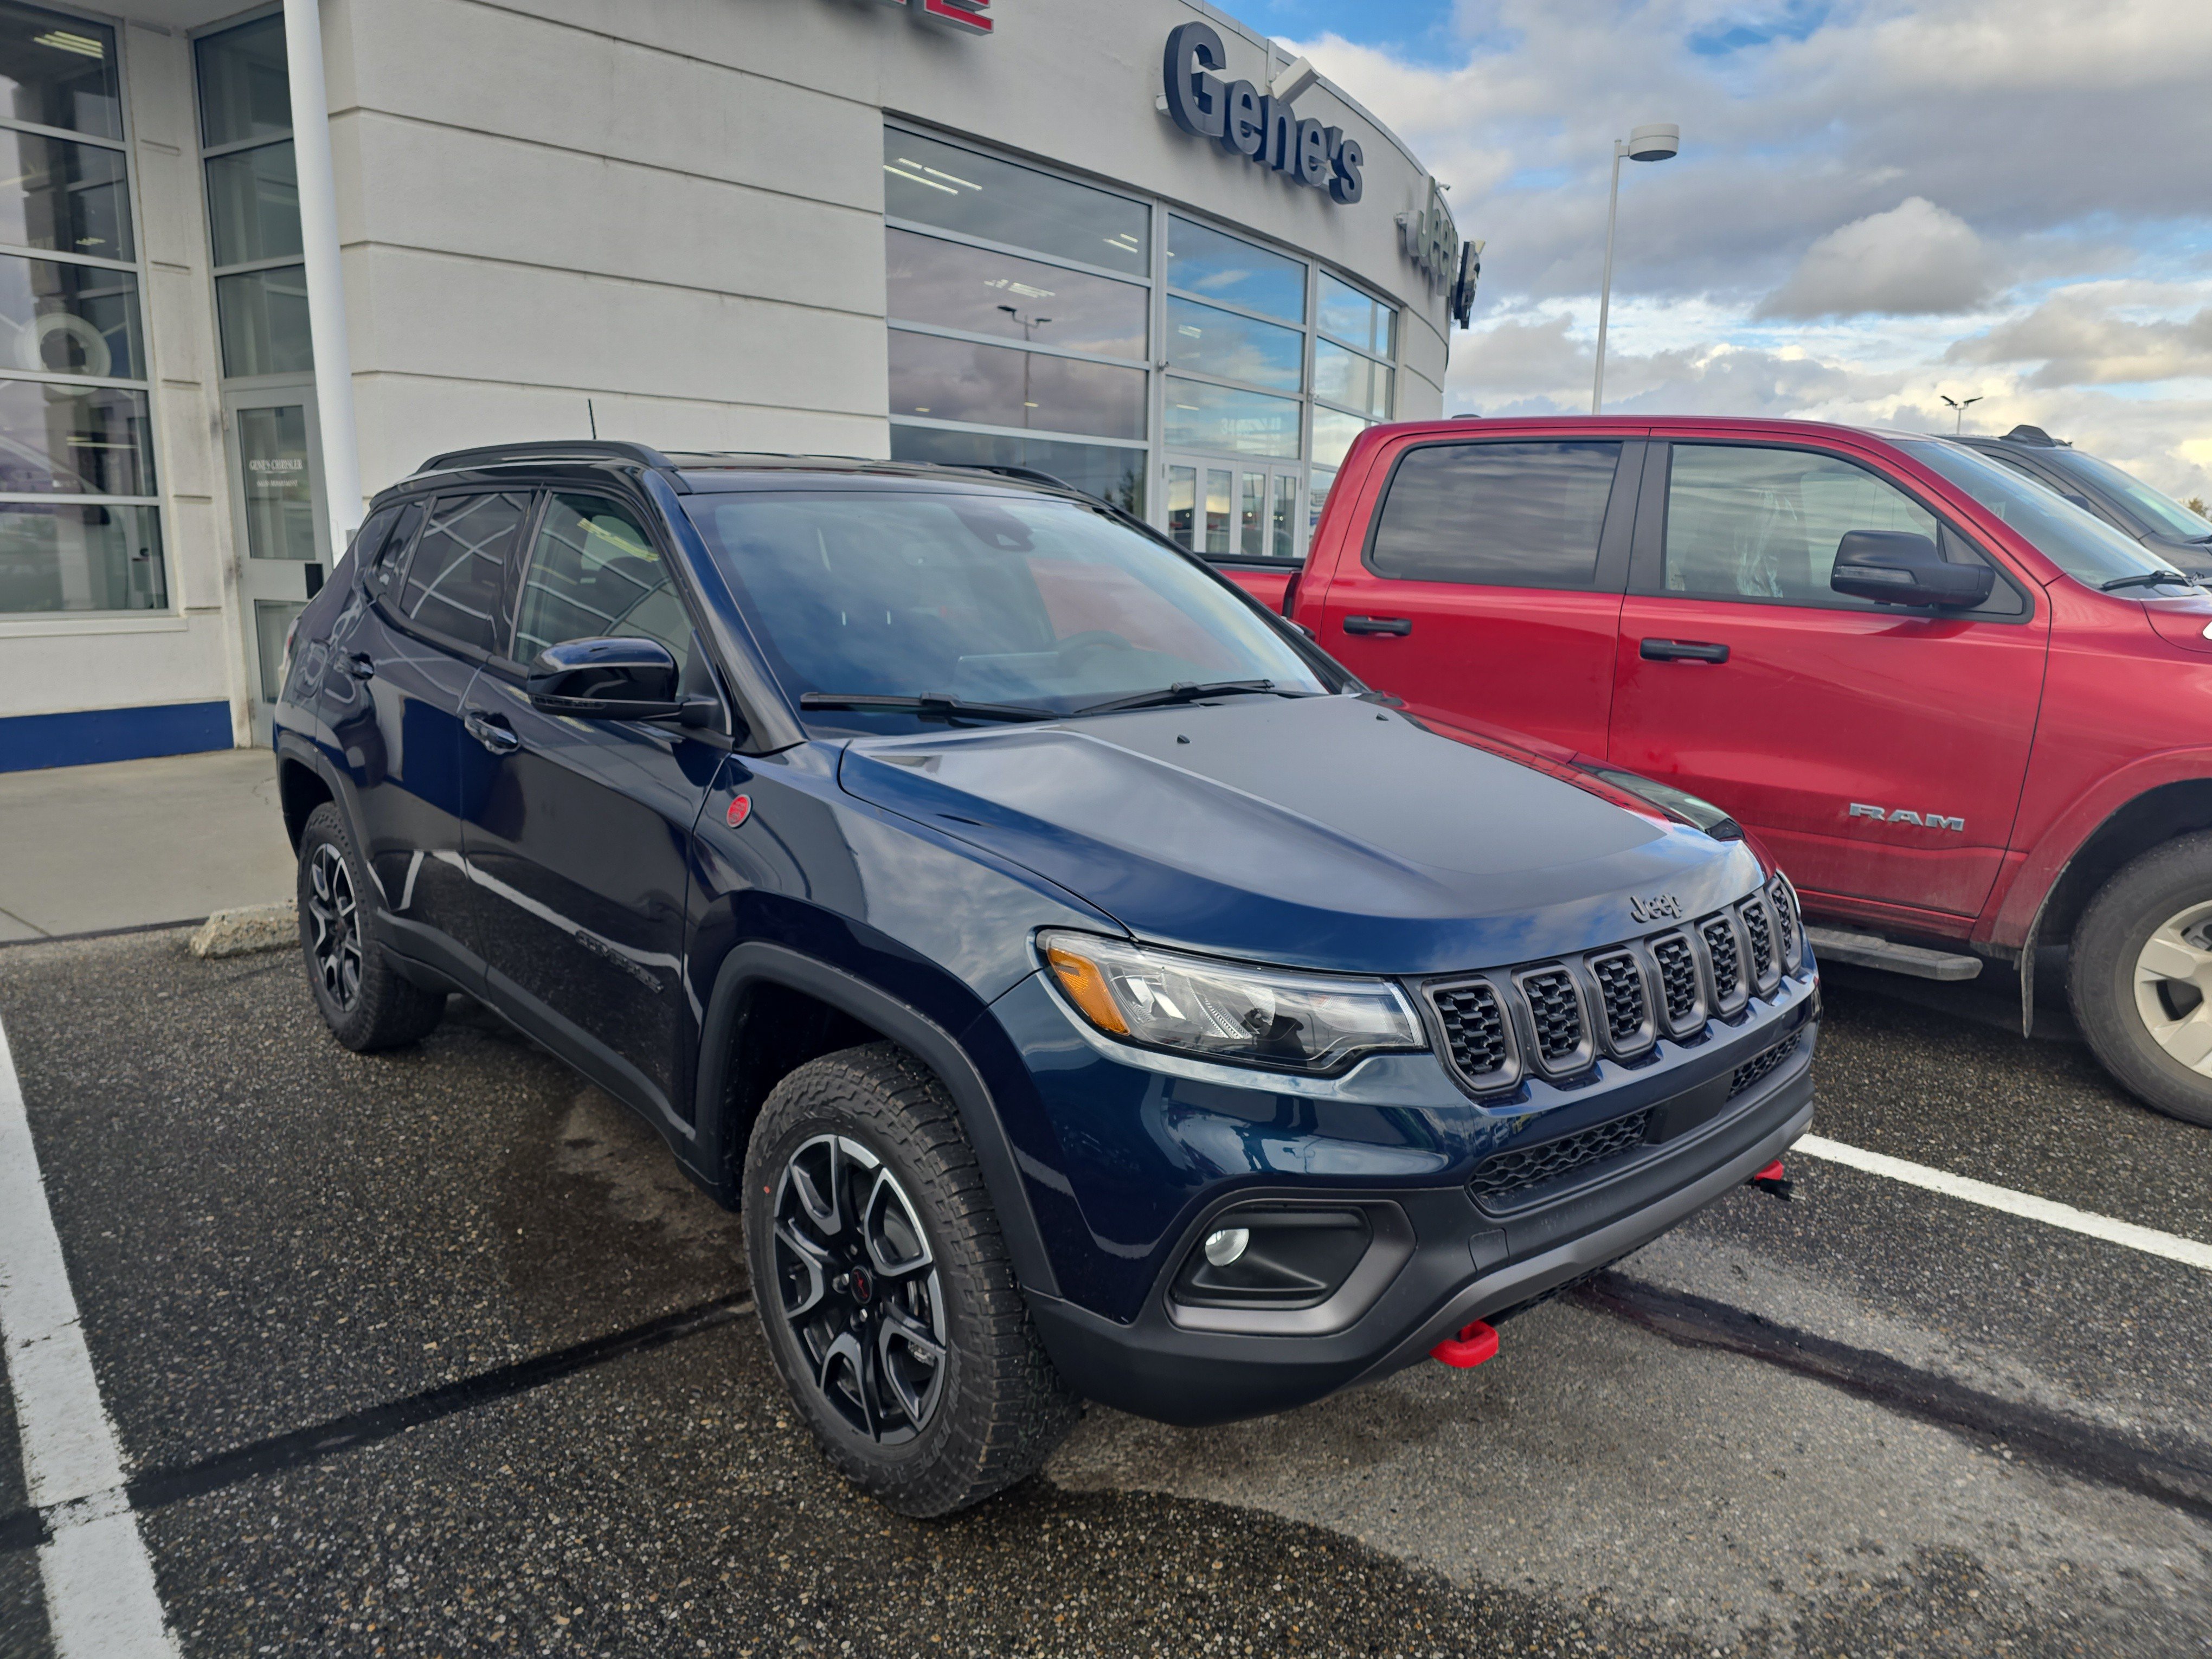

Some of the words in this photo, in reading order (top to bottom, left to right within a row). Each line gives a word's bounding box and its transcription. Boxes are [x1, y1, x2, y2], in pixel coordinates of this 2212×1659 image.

[1163, 21, 1364, 204] Gene's
[1849, 802, 1965, 832] RAM
[1630, 893, 1682, 923] Jeep
